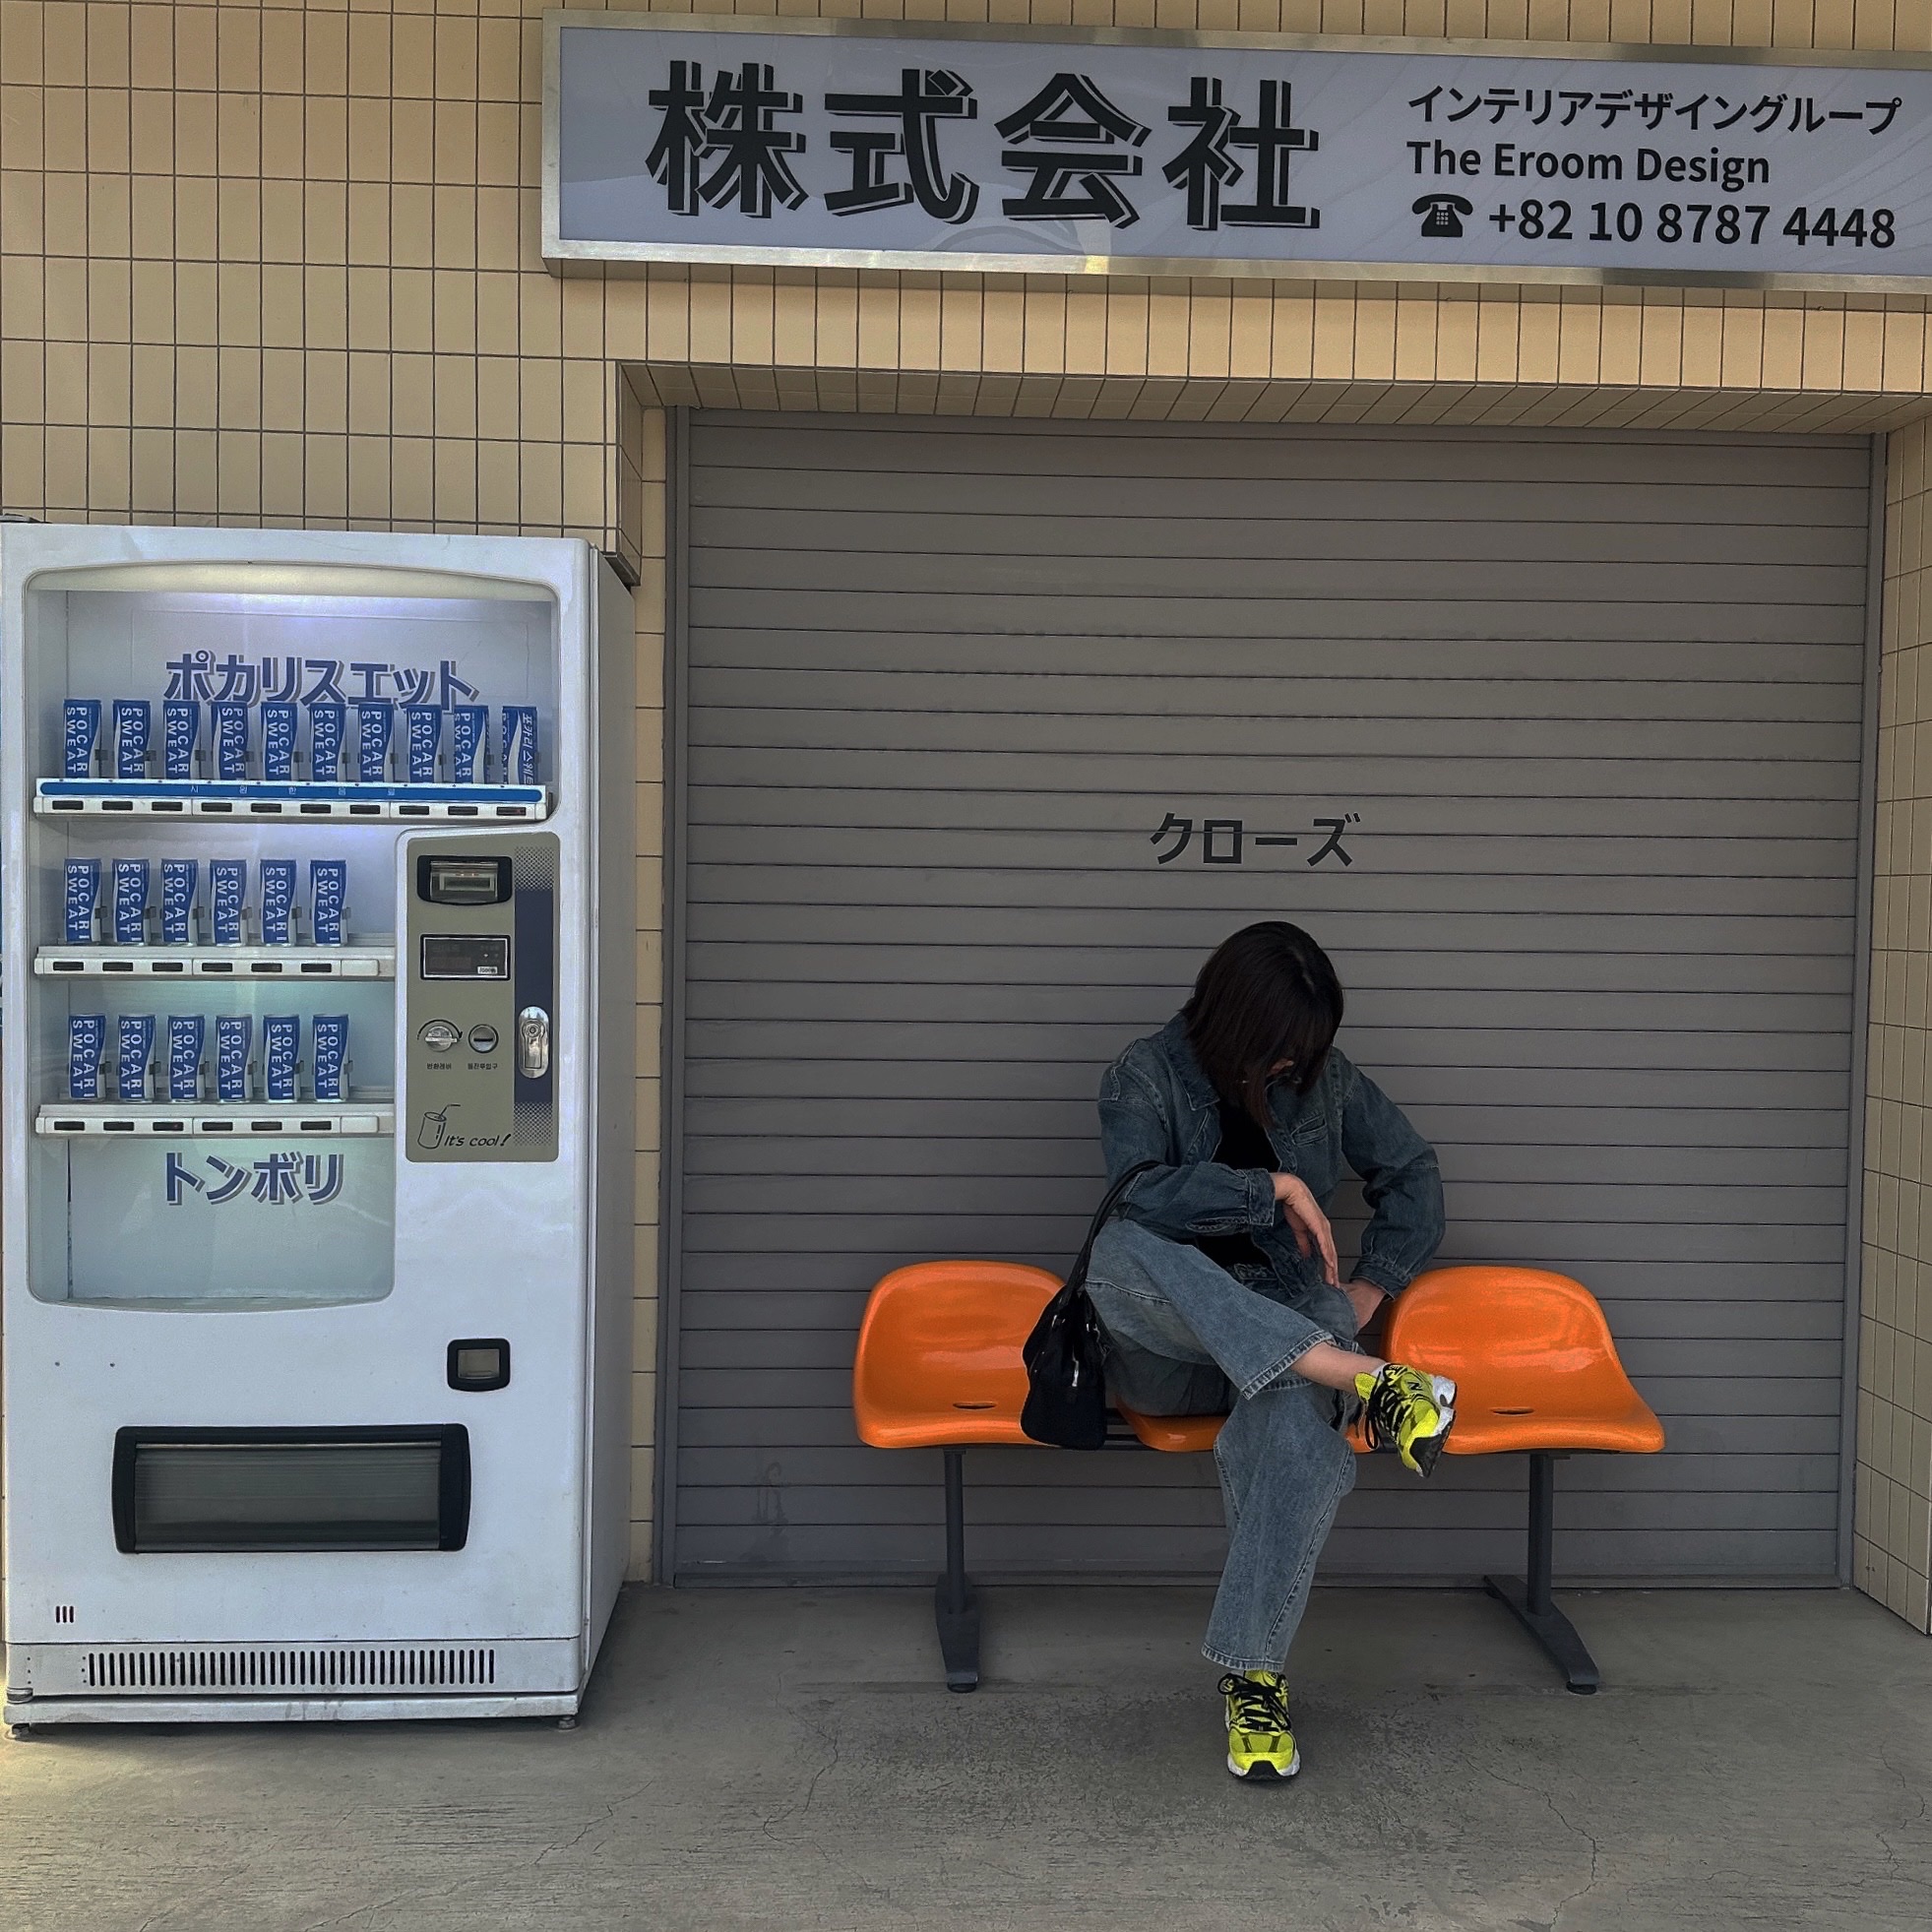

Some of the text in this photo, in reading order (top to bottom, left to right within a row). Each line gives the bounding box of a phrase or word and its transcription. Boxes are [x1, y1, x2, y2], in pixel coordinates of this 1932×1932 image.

[1408, 86, 1902, 135] インテリアデザイングループ
[645, 60, 1320, 230] 株式会社
[1406, 139, 1770, 193] The Eroom Design
[1489, 199, 1896, 248] +82 10 8787 4448
[163, 650, 478, 714] ポカリスエット
[67, 707, 76, 773] SWEAT
[77, 707, 88, 772] POCAR
[121, 708, 133, 774] SWEAT
[133, 708, 144, 773] POCAR
[167, 709, 177, 774] SWEAT
[177, 709, 189, 773] POCAR
[221, 708, 234, 774] SWEAT
[233, 708, 245, 774] POCAR
[267, 710, 280, 775] SWEAT
[279, 710, 290, 775] POCAR
[314, 710, 325, 775] SWEAT
[324, 710, 337, 775] POCAR
[361, 711, 372, 776] SWEAT
[371, 711, 383, 776] POCAR
[411, 712, 422, 777] SWEAT
[421, 712, 433, 777] POCAR
[461, 712, 472, 777] POCAR
[1150, 812, 1361, 867] クローズ
[67, 865, 78, 930] SWEAT
[78, 866, 91, 939] POCARI
[118, 864, 130, 933] SWEAT
[130, 864, 142, 941] POCARI
[163, 864, 174, 933] SWEAT
[174, 864, 186, 941] POCARI
[217, 867, 228, 932] SWEAT
[227, 867, 239, 941] POCARI
[265, 867, 276, 932] SWEAT
[276, 867, 287, 941] POCARI
[317, 868, 329, 932] SWEAT
[328, 868, 340, 941] POCARI
[73, 1020, 84, 1090] SWEAT
[83, 1020, 95, 1097] POCARI
[120, 1021, 131, 1090] SWEAT
[130, 1021, 143, 1098] POCARI
[172, 1021, 184, 1091] SWEAT
[183, 1021, 195, 1098] POCARI
[219, 1022, 231, 1091] SWEAT
[230, 1021, 243, 1098] POCARI
[271, 1024, 282, 1089] SWEAT
[281, 1024, 293, 1097] POCARI
[317, 1024, 328, 1089] SWEAT
[327, 1024, 339, 1097] POCARI
[444, 1135, 465, 1147] It's
[166, 1152, 343, 1206] トンボリ
